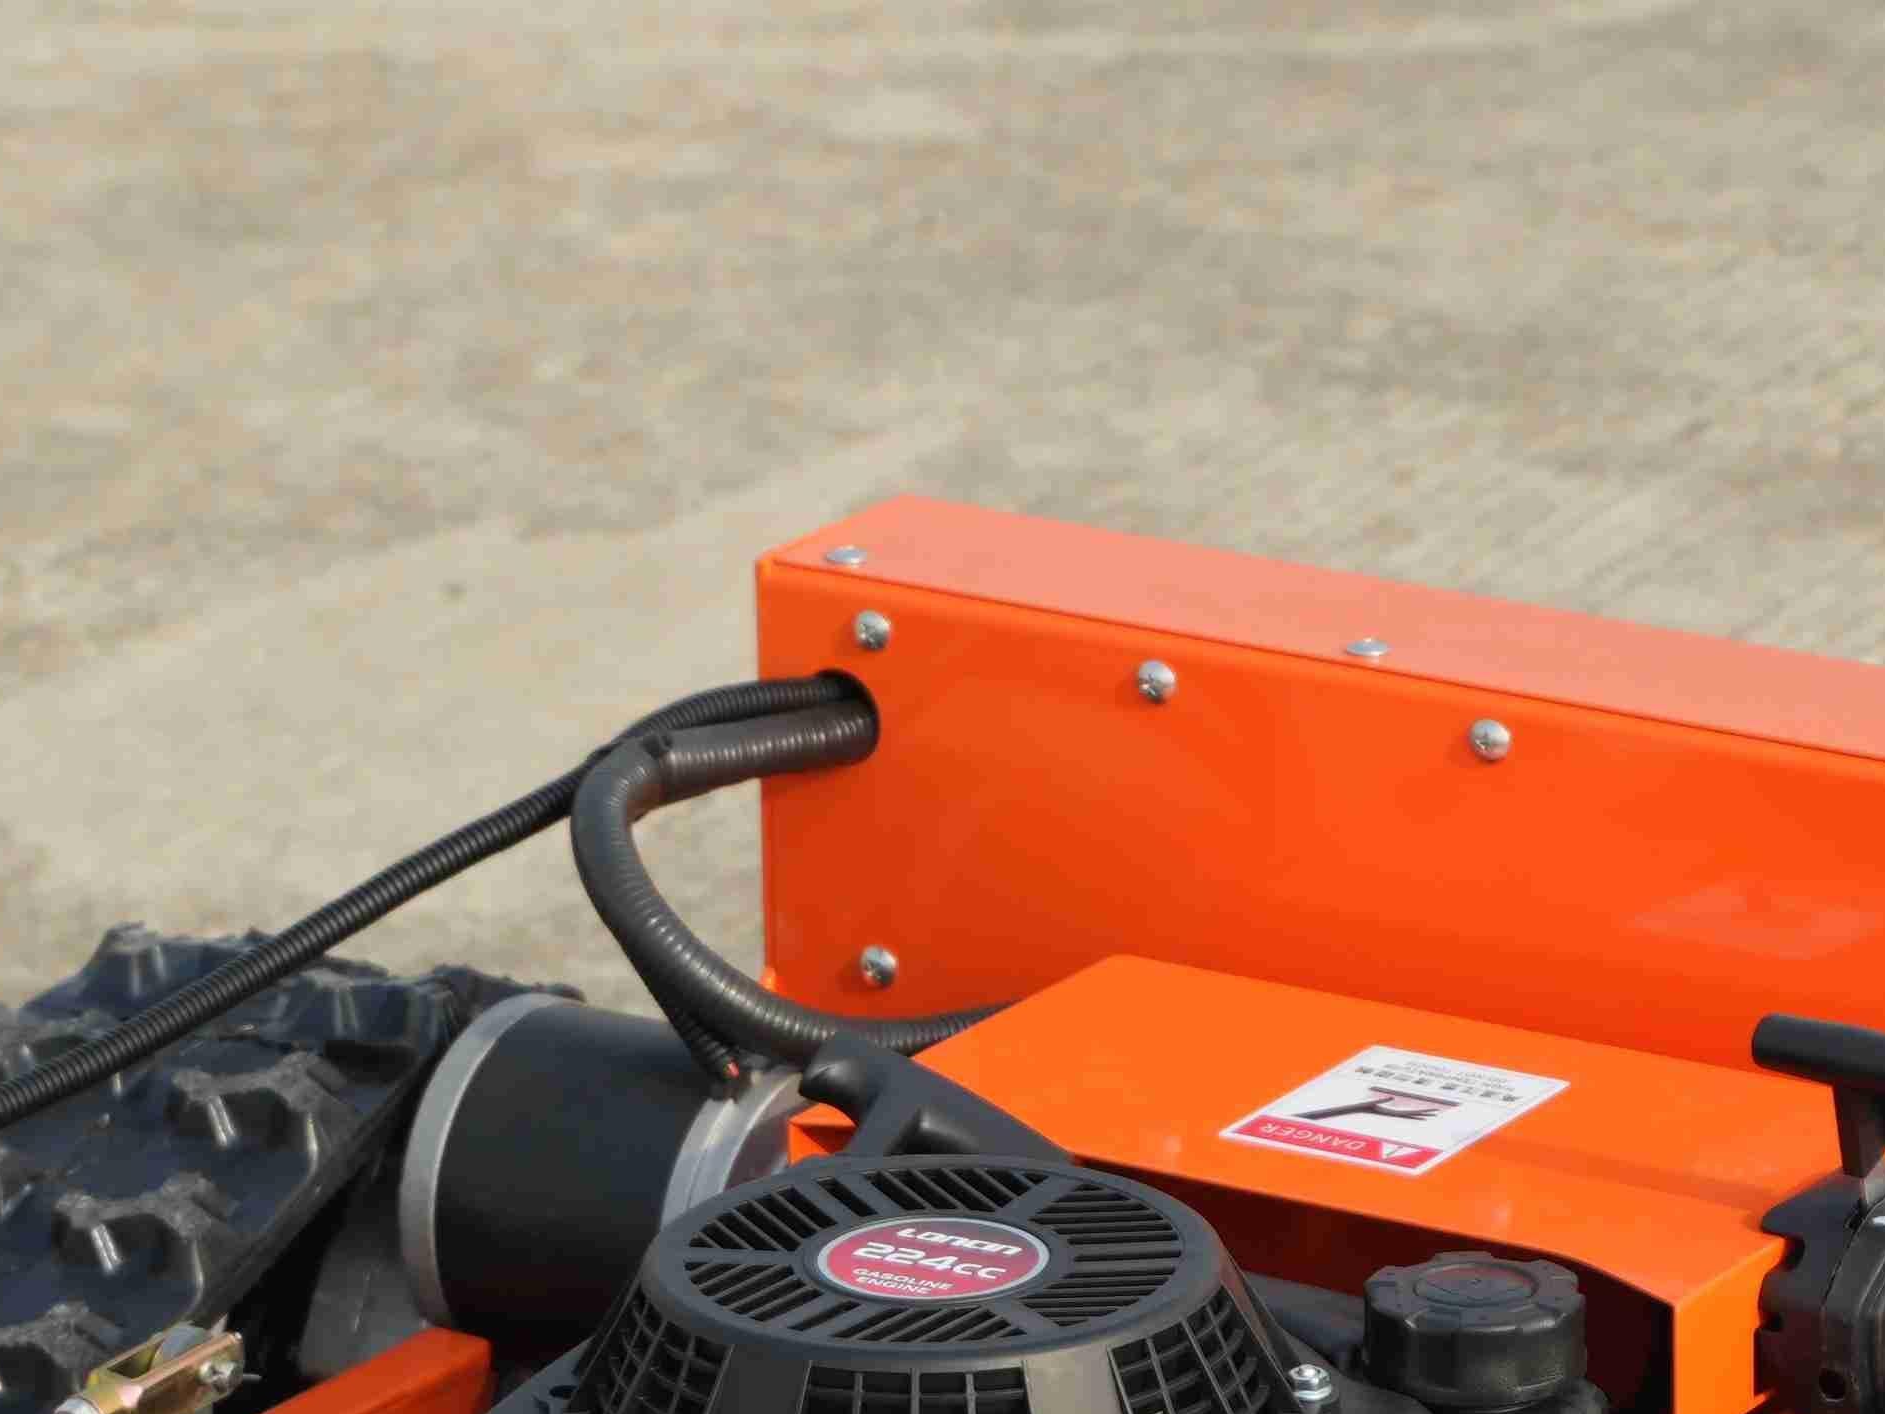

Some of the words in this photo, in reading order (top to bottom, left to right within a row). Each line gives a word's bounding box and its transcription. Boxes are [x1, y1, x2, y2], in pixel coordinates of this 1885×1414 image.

[1259, 1121, 1367, 1151] DANGER
[852, 1267, 954, 1290] GASOLINE
[857, 1275, 933, 1295] ENGINE
